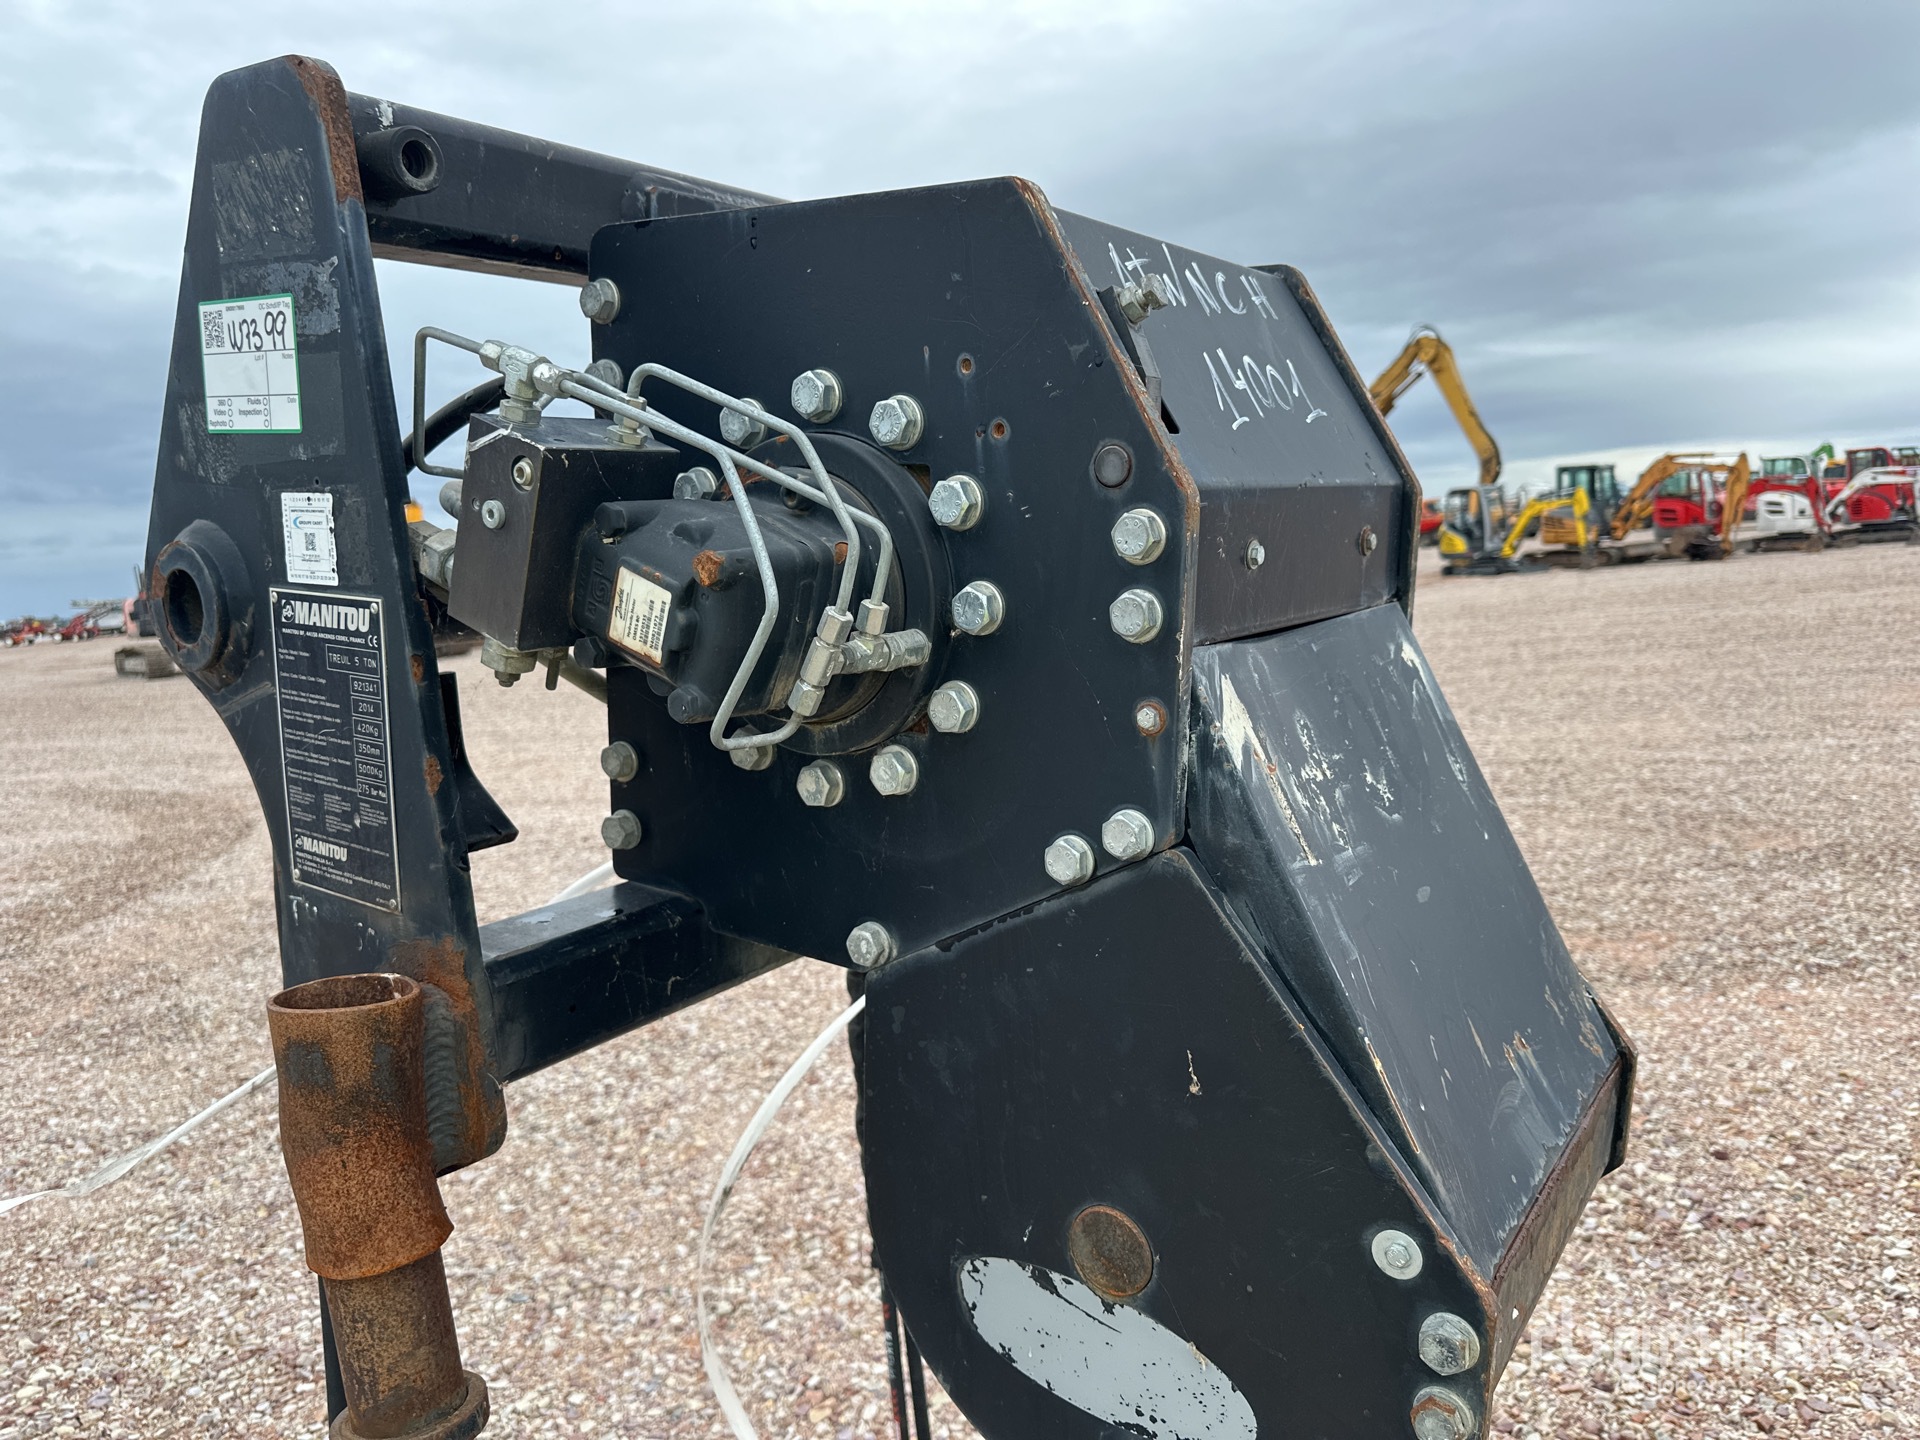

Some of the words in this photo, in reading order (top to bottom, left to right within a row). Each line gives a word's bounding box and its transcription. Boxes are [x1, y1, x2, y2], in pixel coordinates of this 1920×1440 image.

[247, 397, 262, 405] Fluids
[213, 408, 227, 416] Video
[238, 408, 262, 418] Inspection
[295, 601, 370, 633] MANITOU
[328, 653, 351, 665] TREUIL
[354, 656, 360, 666] 5
[363, 657, 377, 668] TON
[353, 680, 377, 693] 921341
[358, 702, 374, 712] 2014
[303, 836, 348, 861] MANITOU
